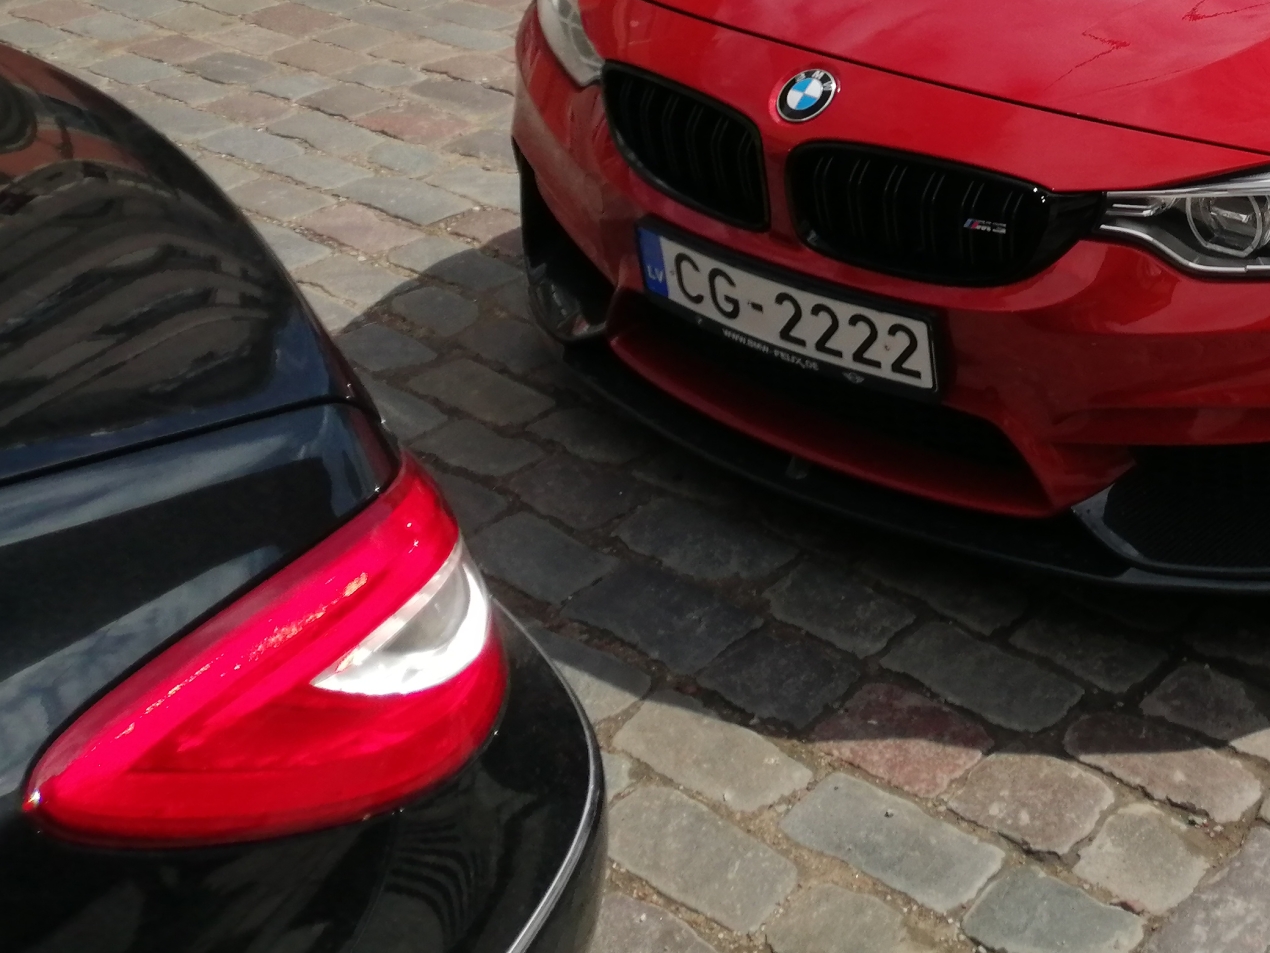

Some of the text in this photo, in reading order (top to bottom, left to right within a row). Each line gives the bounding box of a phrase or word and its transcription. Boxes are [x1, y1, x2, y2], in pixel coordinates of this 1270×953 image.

[795, 70, 833, 91] BMW
[646, 265, 664, 283] LV
[674, 252, 923, 380] CG-2222
